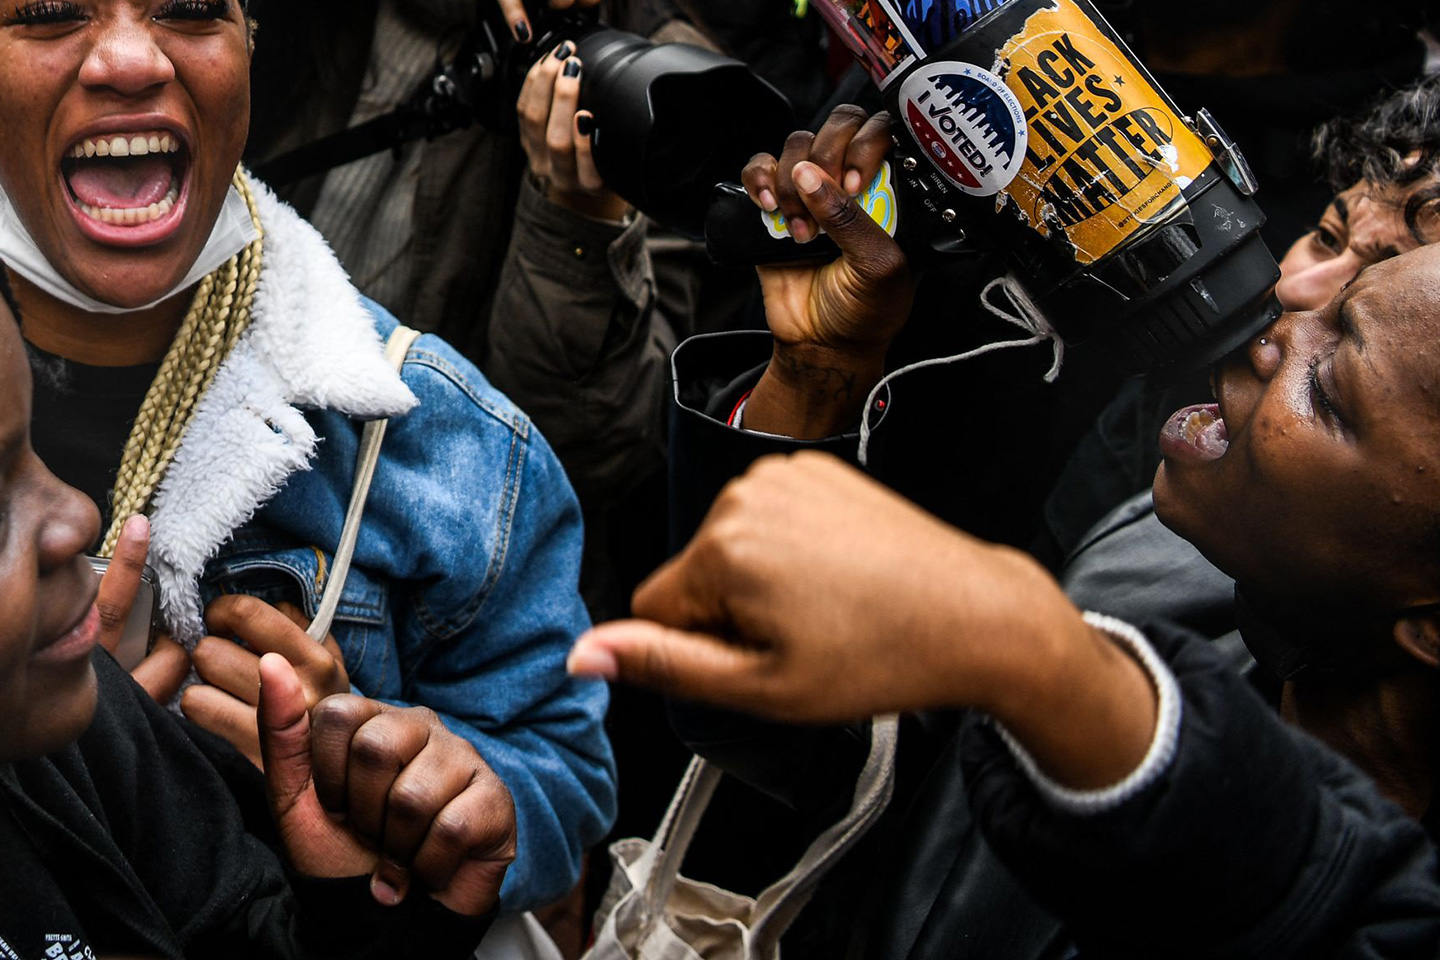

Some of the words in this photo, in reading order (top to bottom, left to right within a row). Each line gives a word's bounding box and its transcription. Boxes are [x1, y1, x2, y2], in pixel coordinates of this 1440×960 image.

[917, 90, 931, 105] I
[928, 103, 994, 178] VOTED!
[1003, 91, 1023, 125] ELECTIONS
[1028, 73, 1124, 175] LIVES
[930, 172, 949, 194] SIREN
[1044, 106, 1174, 228] MATTER
[923, 198, 937, 213] OFF
